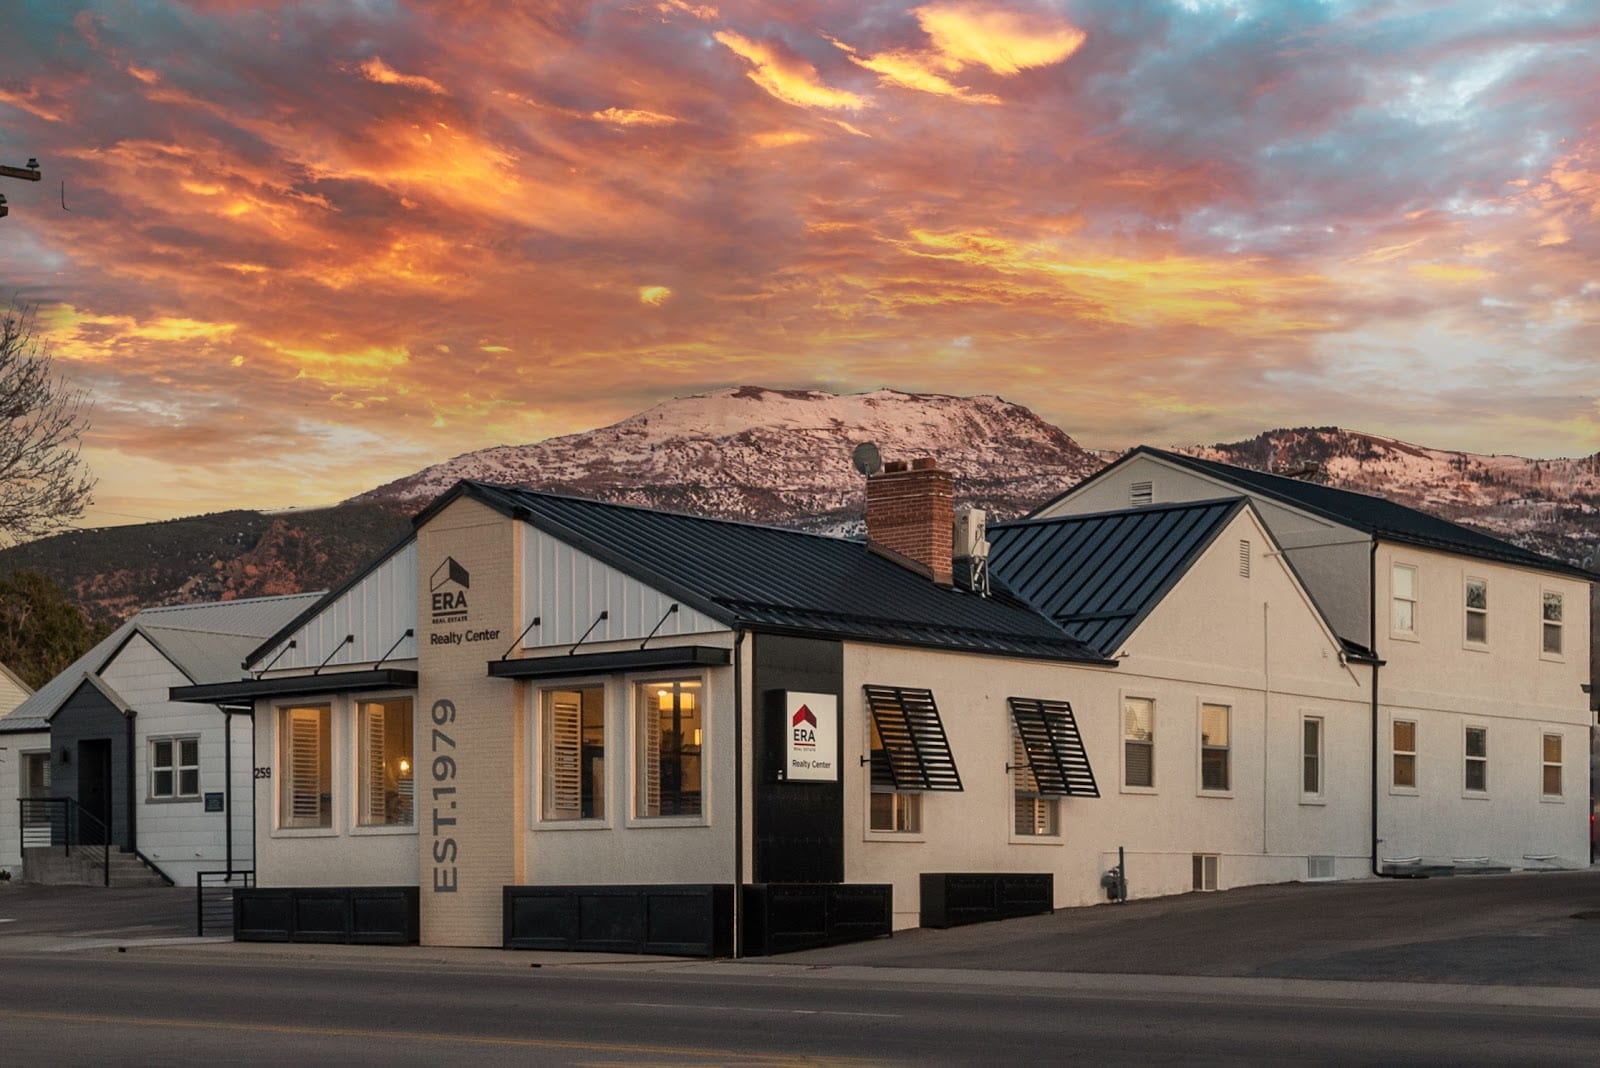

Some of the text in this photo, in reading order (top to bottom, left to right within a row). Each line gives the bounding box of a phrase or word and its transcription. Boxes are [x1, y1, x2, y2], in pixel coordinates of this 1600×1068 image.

[432, 590, 468, 610] ERA
[430, 629, 500, 645] Realty Center
[793, 728, 816, 742] ERA
[792, 759, 831, 769] Realty Center
